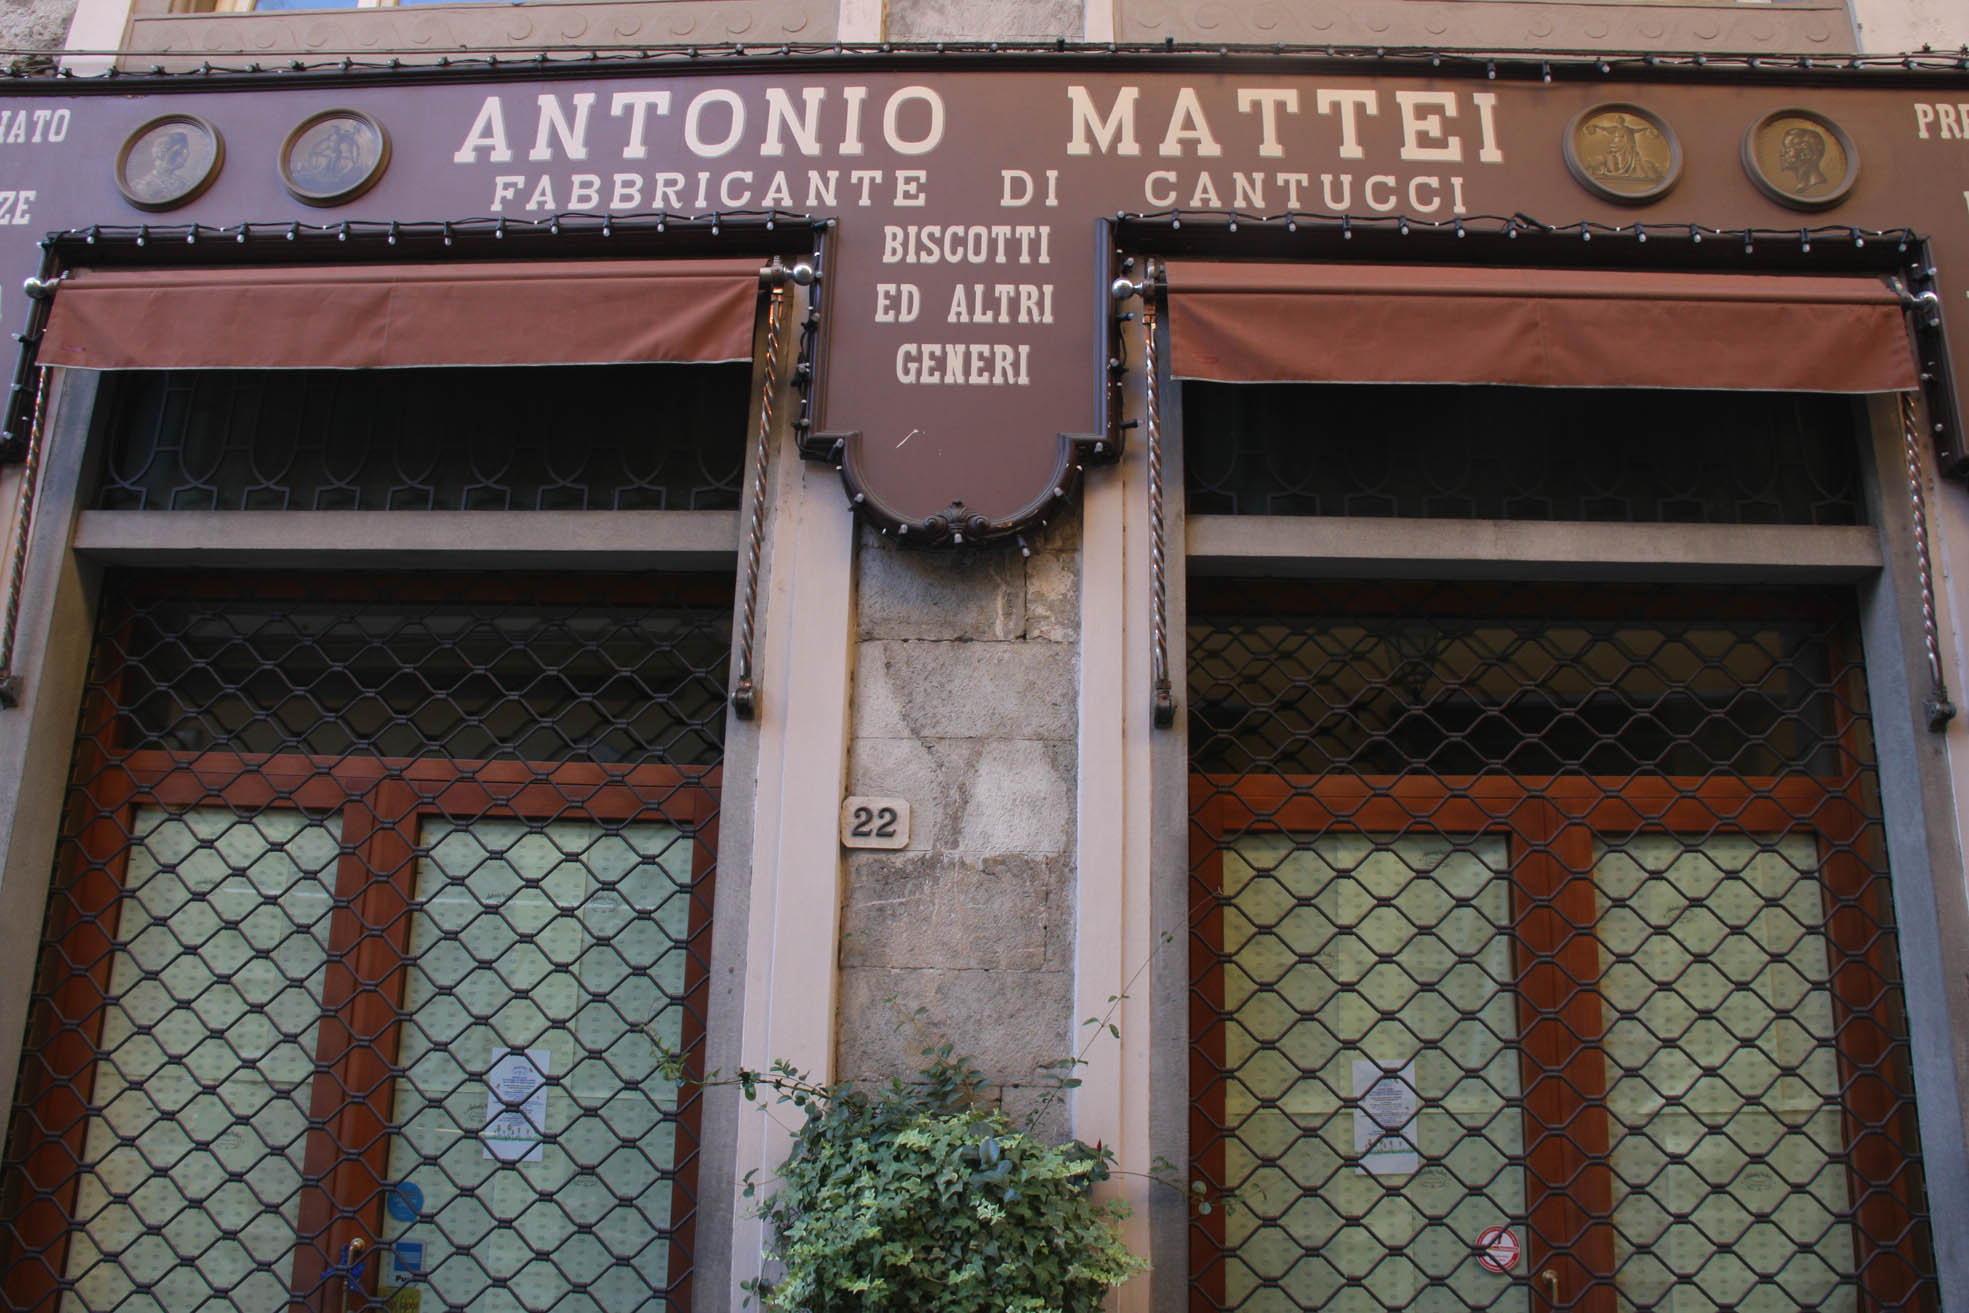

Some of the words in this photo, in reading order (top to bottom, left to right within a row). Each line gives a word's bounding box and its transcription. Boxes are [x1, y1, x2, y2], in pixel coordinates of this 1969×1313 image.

[453, 86, 945, 163] ANTONIO
[1066, 85, 1503, 162] MATTEI
[490, 170, 927, 212] FABBRICANTE
[1000, 169, 1060, 207] DI
[1144, 170, 1466, 213] CANTUCCI
[882, 225, 1051, 264] BISCOTTI
[874, 283, 921, 323] ED
[947, 283, 1055, 324] ALTRI
[896, 343, 1031, 385] GENERI
[851, 806, 898, 838] 22
